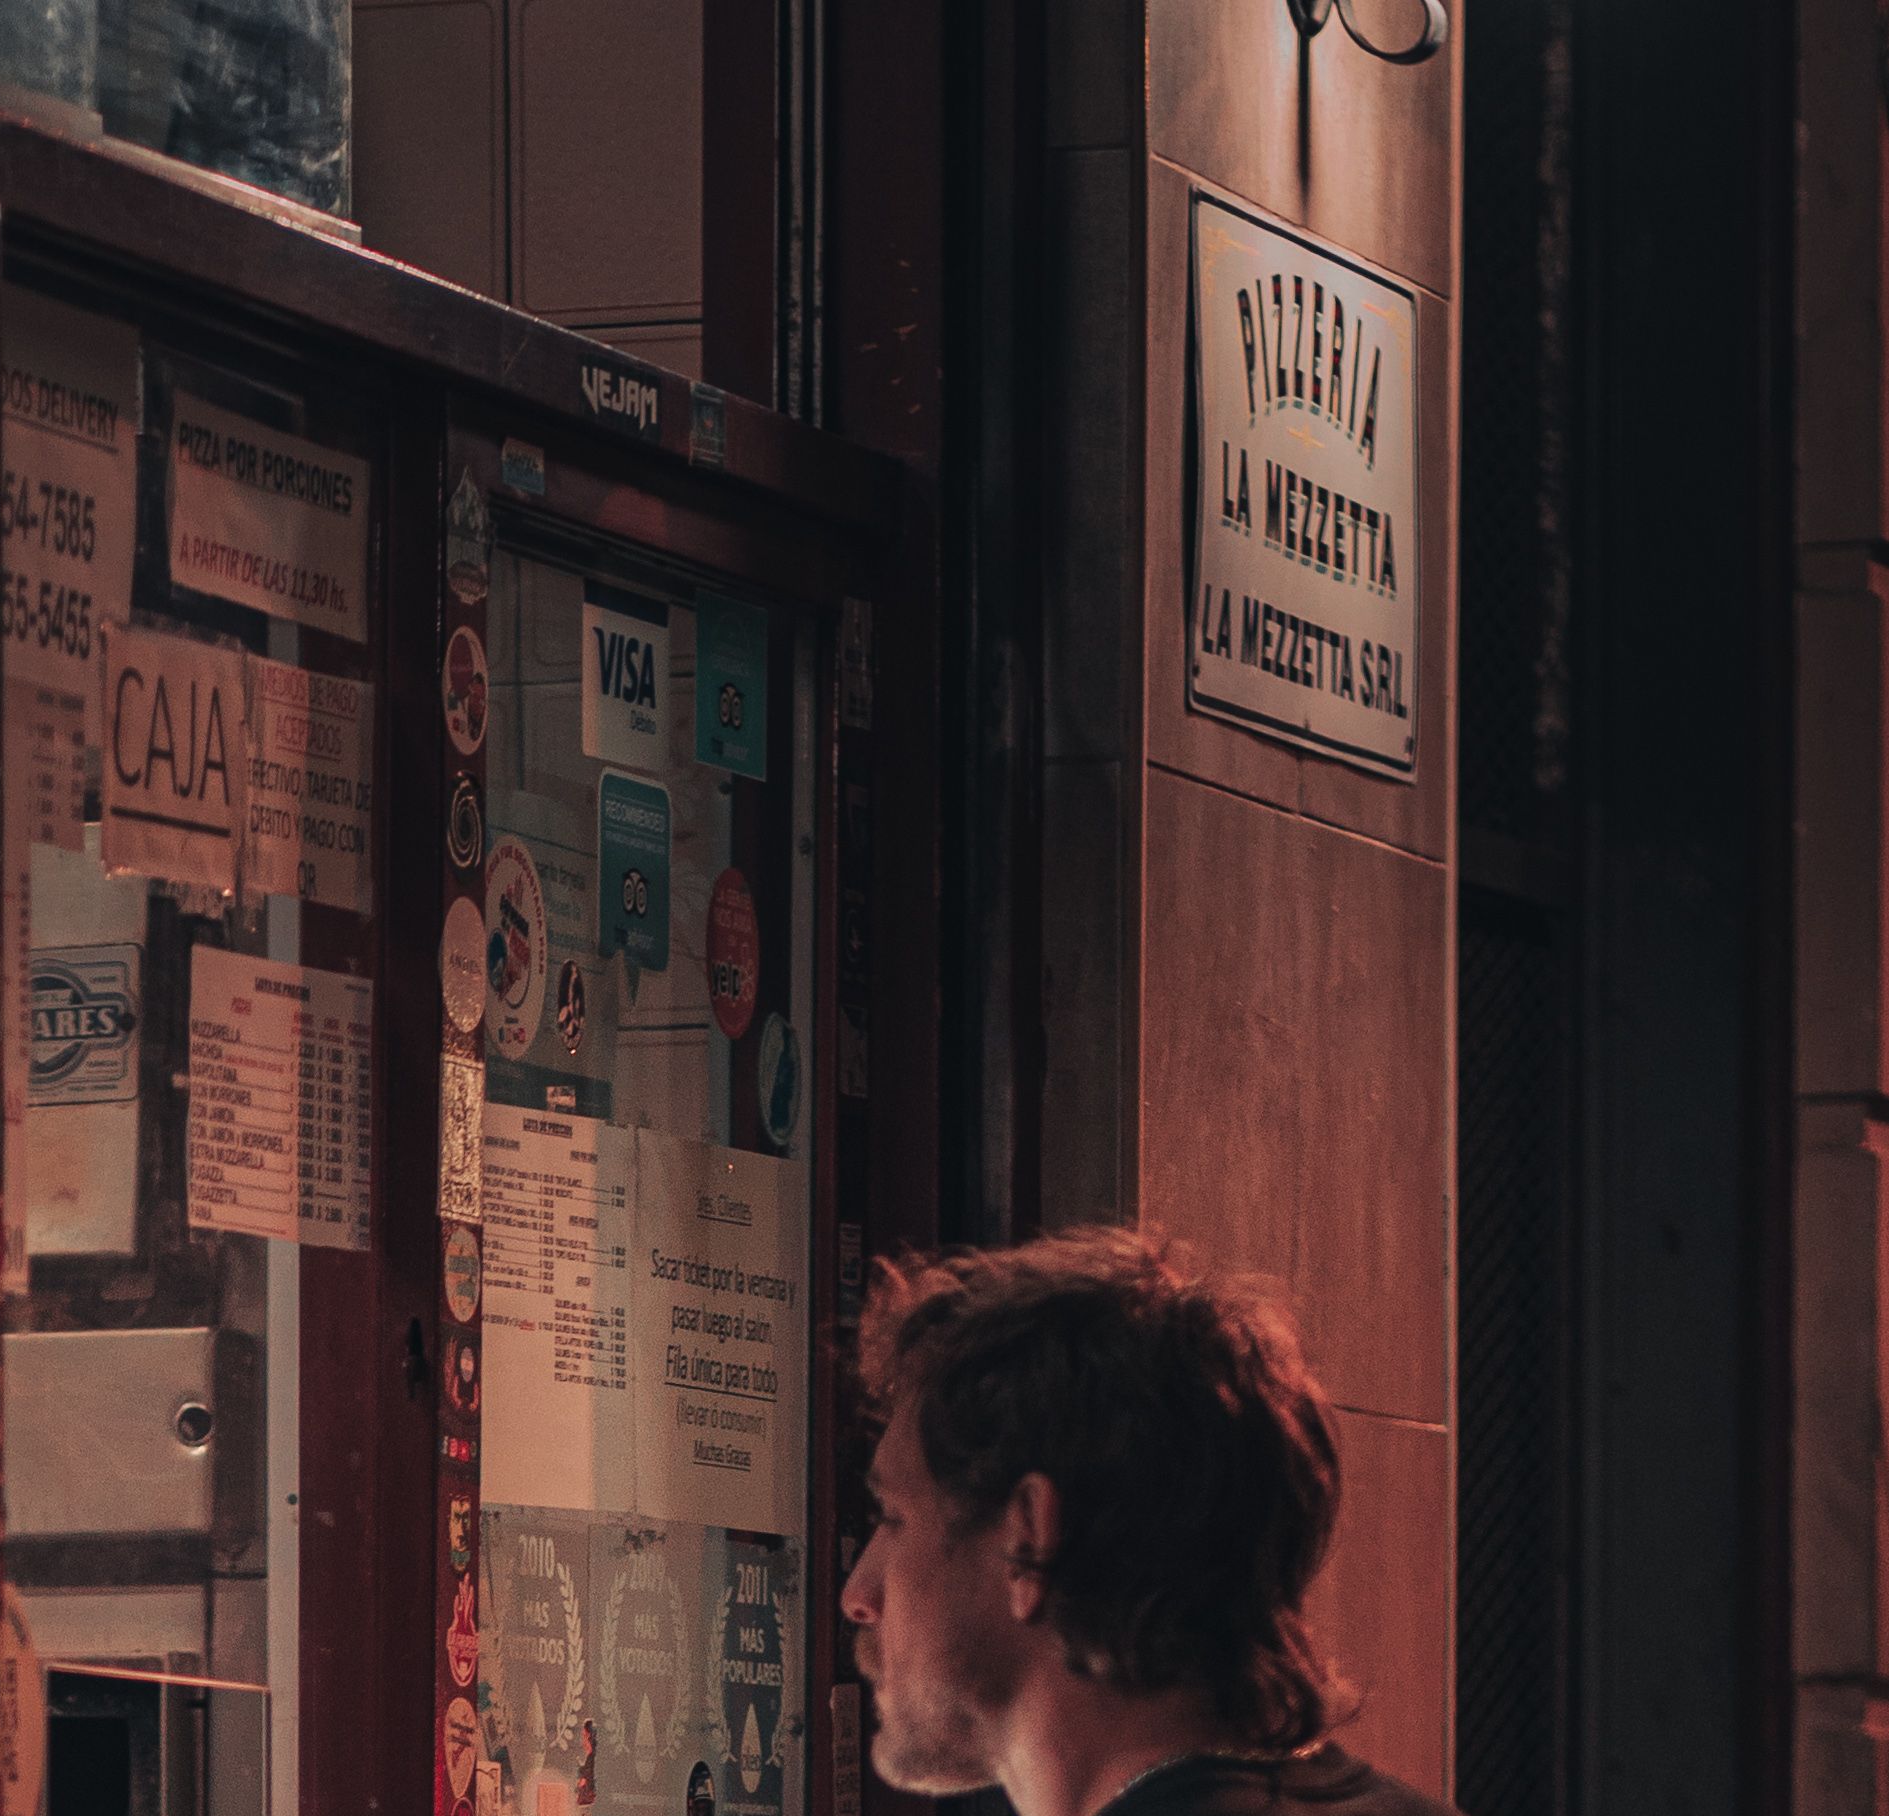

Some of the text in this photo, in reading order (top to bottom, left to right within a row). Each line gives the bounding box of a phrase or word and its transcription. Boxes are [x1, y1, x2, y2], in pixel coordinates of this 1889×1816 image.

[1237, 273, 1380, 470] PIZZERIA
[38, 377, 119, 441] DELIVERY
[581, 365, 658, 430] VEJAM
[179, 421, 353, 515] PIZZA POR PORCIONES
[1222, 441, 1397, 594] LA MEZZETTA
[178, 533, 189, 564] A
[192, 538, 240, 579] PARTIR
[241, 552, 262, 587] DE
[263, 558, 289, 595] LAS
[290, 566, 329, 608] 11,30
[1202, 583, 1232, 660] LA
[1241, 595, 1355, 702] MEZZETTA
[593, 627, 657, 710] VISA
[328, 679, 358, 713] PAGO
[114, 666, 230, 806] CAJA
[306, 769, 353, 807] TARJETA
[355, 781, 372, 811] DE
[303, 815, 335, 850] PAGO
[339, 823, 366, 855] CON
[711, 963, 741, 998] yelp
[651, 1248, 797, 1310] Sacar ticket por la ventana y
[671, 1304, 701, 1334] pasar
[702, 1302, 733, 1343] luego
[733, 1308, 745, 1340] al
[665, 1344, 779, 1395] Fila única para todo
[693, 1440, 752, 1467] Muchas Gracias
[518, 1534, 555, 1580] 2010
[736, 1562, 770, 1606] 2011
[522, 1592, 550, 1629] MÁS
[738, 1619, 766, 1654] MÁS
[722, 1659, 783, 1687] POPULARES
